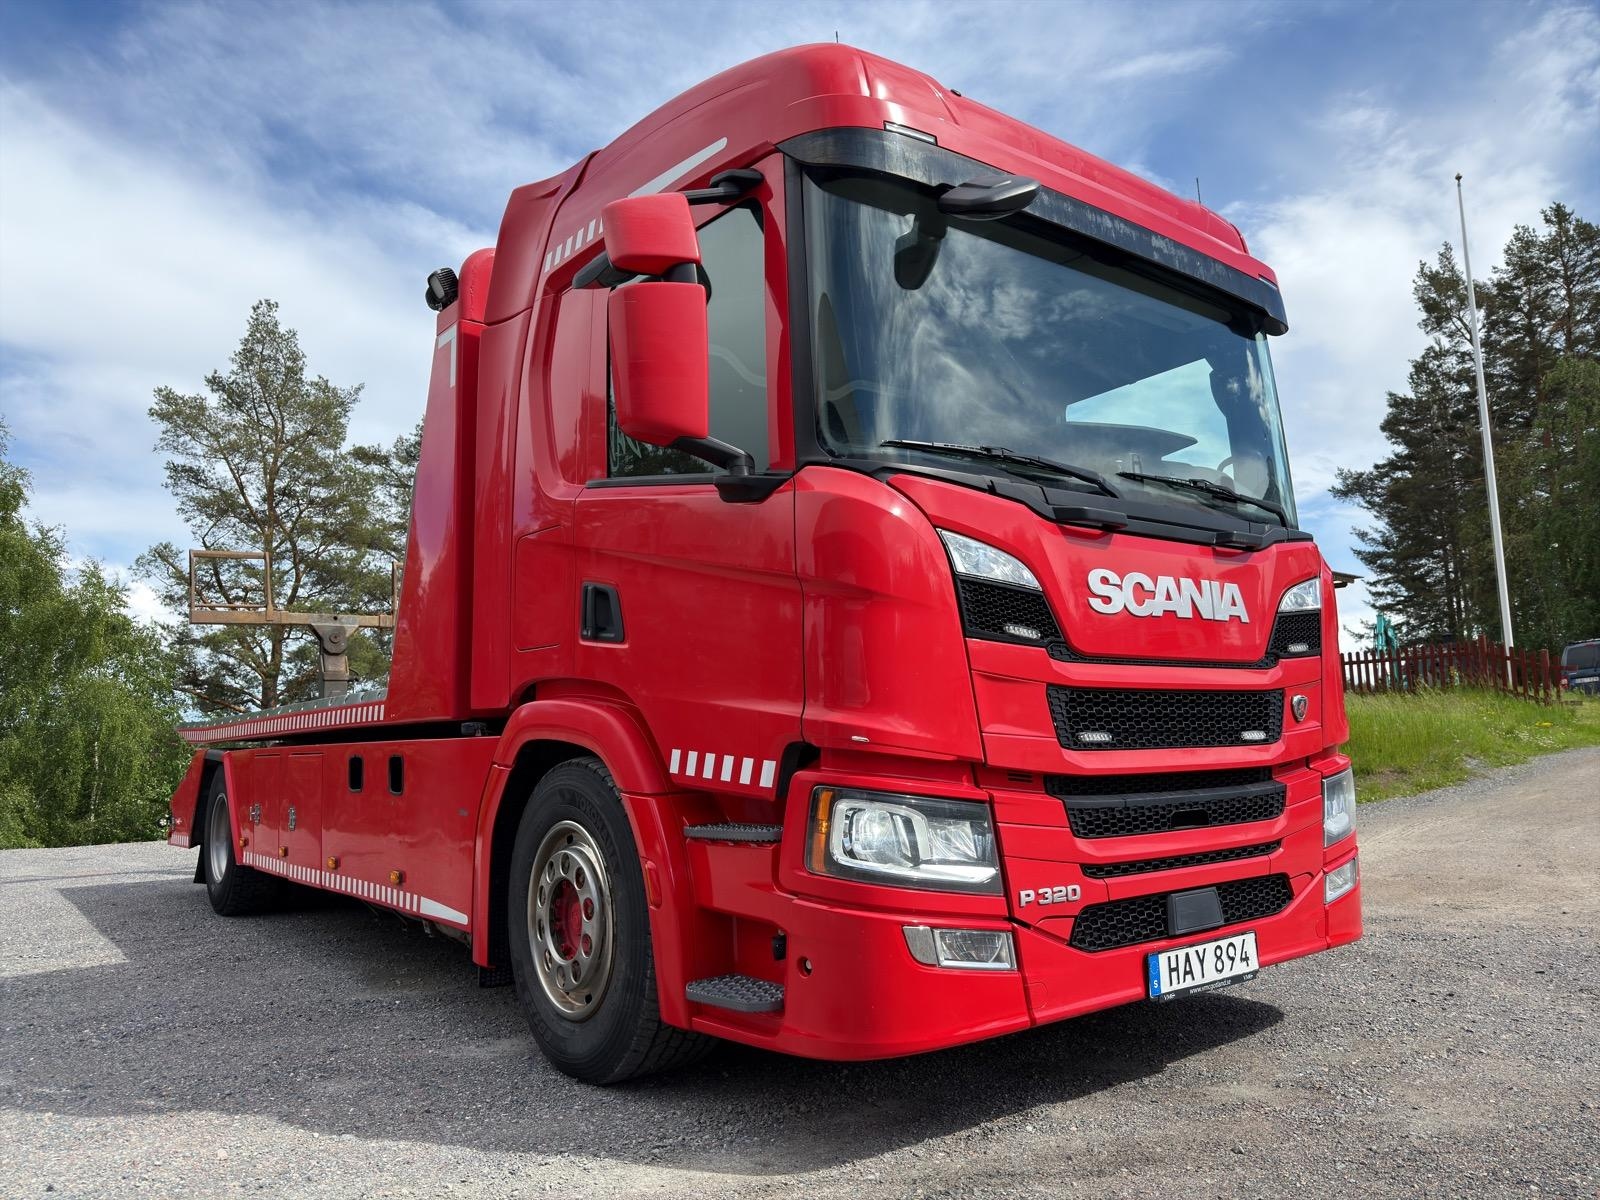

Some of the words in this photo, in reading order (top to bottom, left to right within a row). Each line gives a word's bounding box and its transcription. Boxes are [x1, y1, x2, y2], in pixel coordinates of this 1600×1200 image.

[1087, 568, 1250, 623] SCANIA
[1019, 889, 1035, 907] P
[1038, 884, 1081, 905] 320
[1167, 947, 1207, 987] HAY
[1214, 938, 1250, 975] 894
[1153, 979, 1159, 989] S
